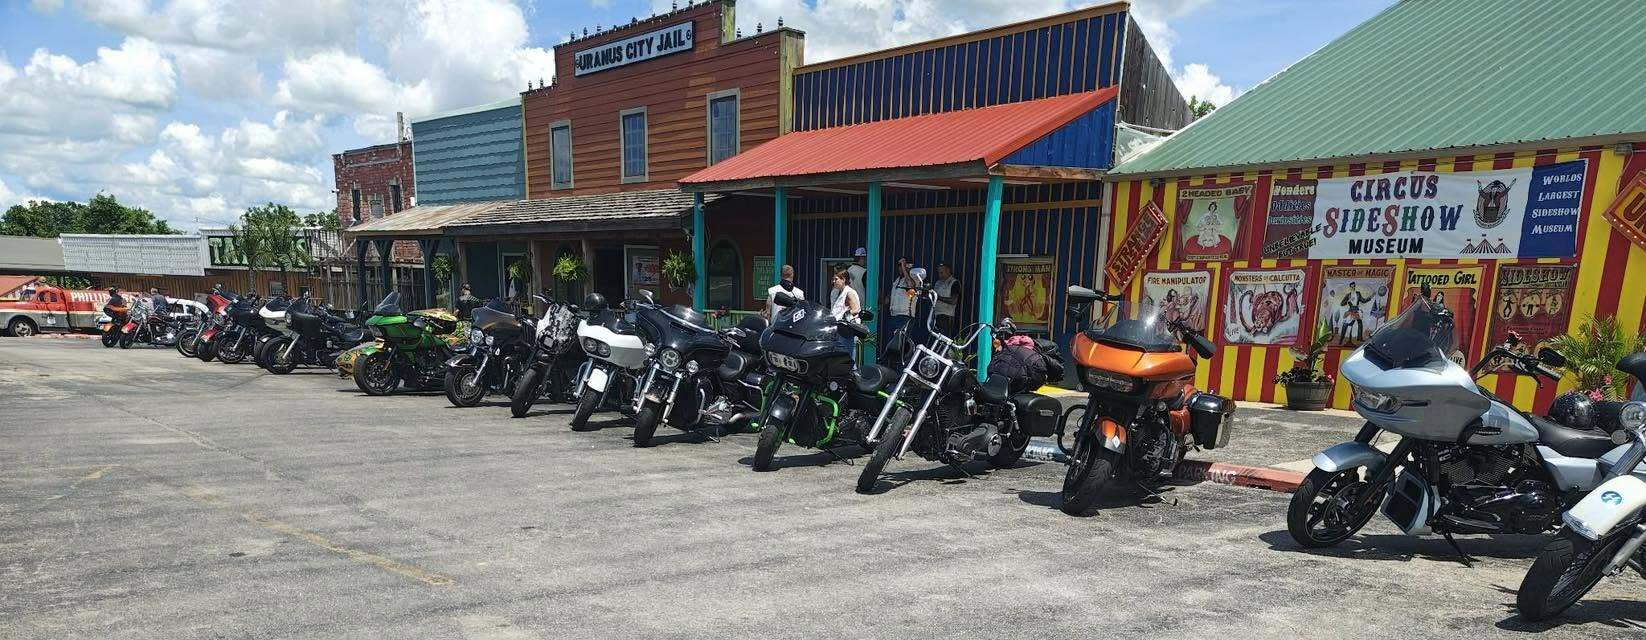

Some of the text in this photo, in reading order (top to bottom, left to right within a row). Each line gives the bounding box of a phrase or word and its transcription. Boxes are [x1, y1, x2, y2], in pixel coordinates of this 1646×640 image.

[577, 29, 685, 70] URANUS CITY JAIL
[1543, 173, 1583, 186] WORLDS
[1182, 185, 1252, 198] 2 HEADED BABY
[1272, 184, 1316, 196] Wonders
[1350, 175, 1439, 202] CIRCUS
[1537, 190, 1580, 202] LARGEST
[1531, 207, 1579, 218] SIDESHOW
[1323, 204, 1464, 239] SIDESHOW
[1531, 224, 1573, 235] MUSEUM
[1263, 223, 1322, 255] UNBELIEVABLE
[1348, 238, 1424, 255] MUSEUM
[1269, 274, 1300, 282] CALCUTTA
[1328, 269, 1357, 277] MASTER
[1365, 269, 1389, 277] MAGIC
[1408, 270, 1477, 285] TATTOOED GIRL
[1500, 268, 1569, 287] SIDESHOW
[1147, 276, 1207, 285] FIRE MANIPULATOR
[70, 291, 113, 303] PHILLIP
[1179, 466, 1236, 482] PARKING
